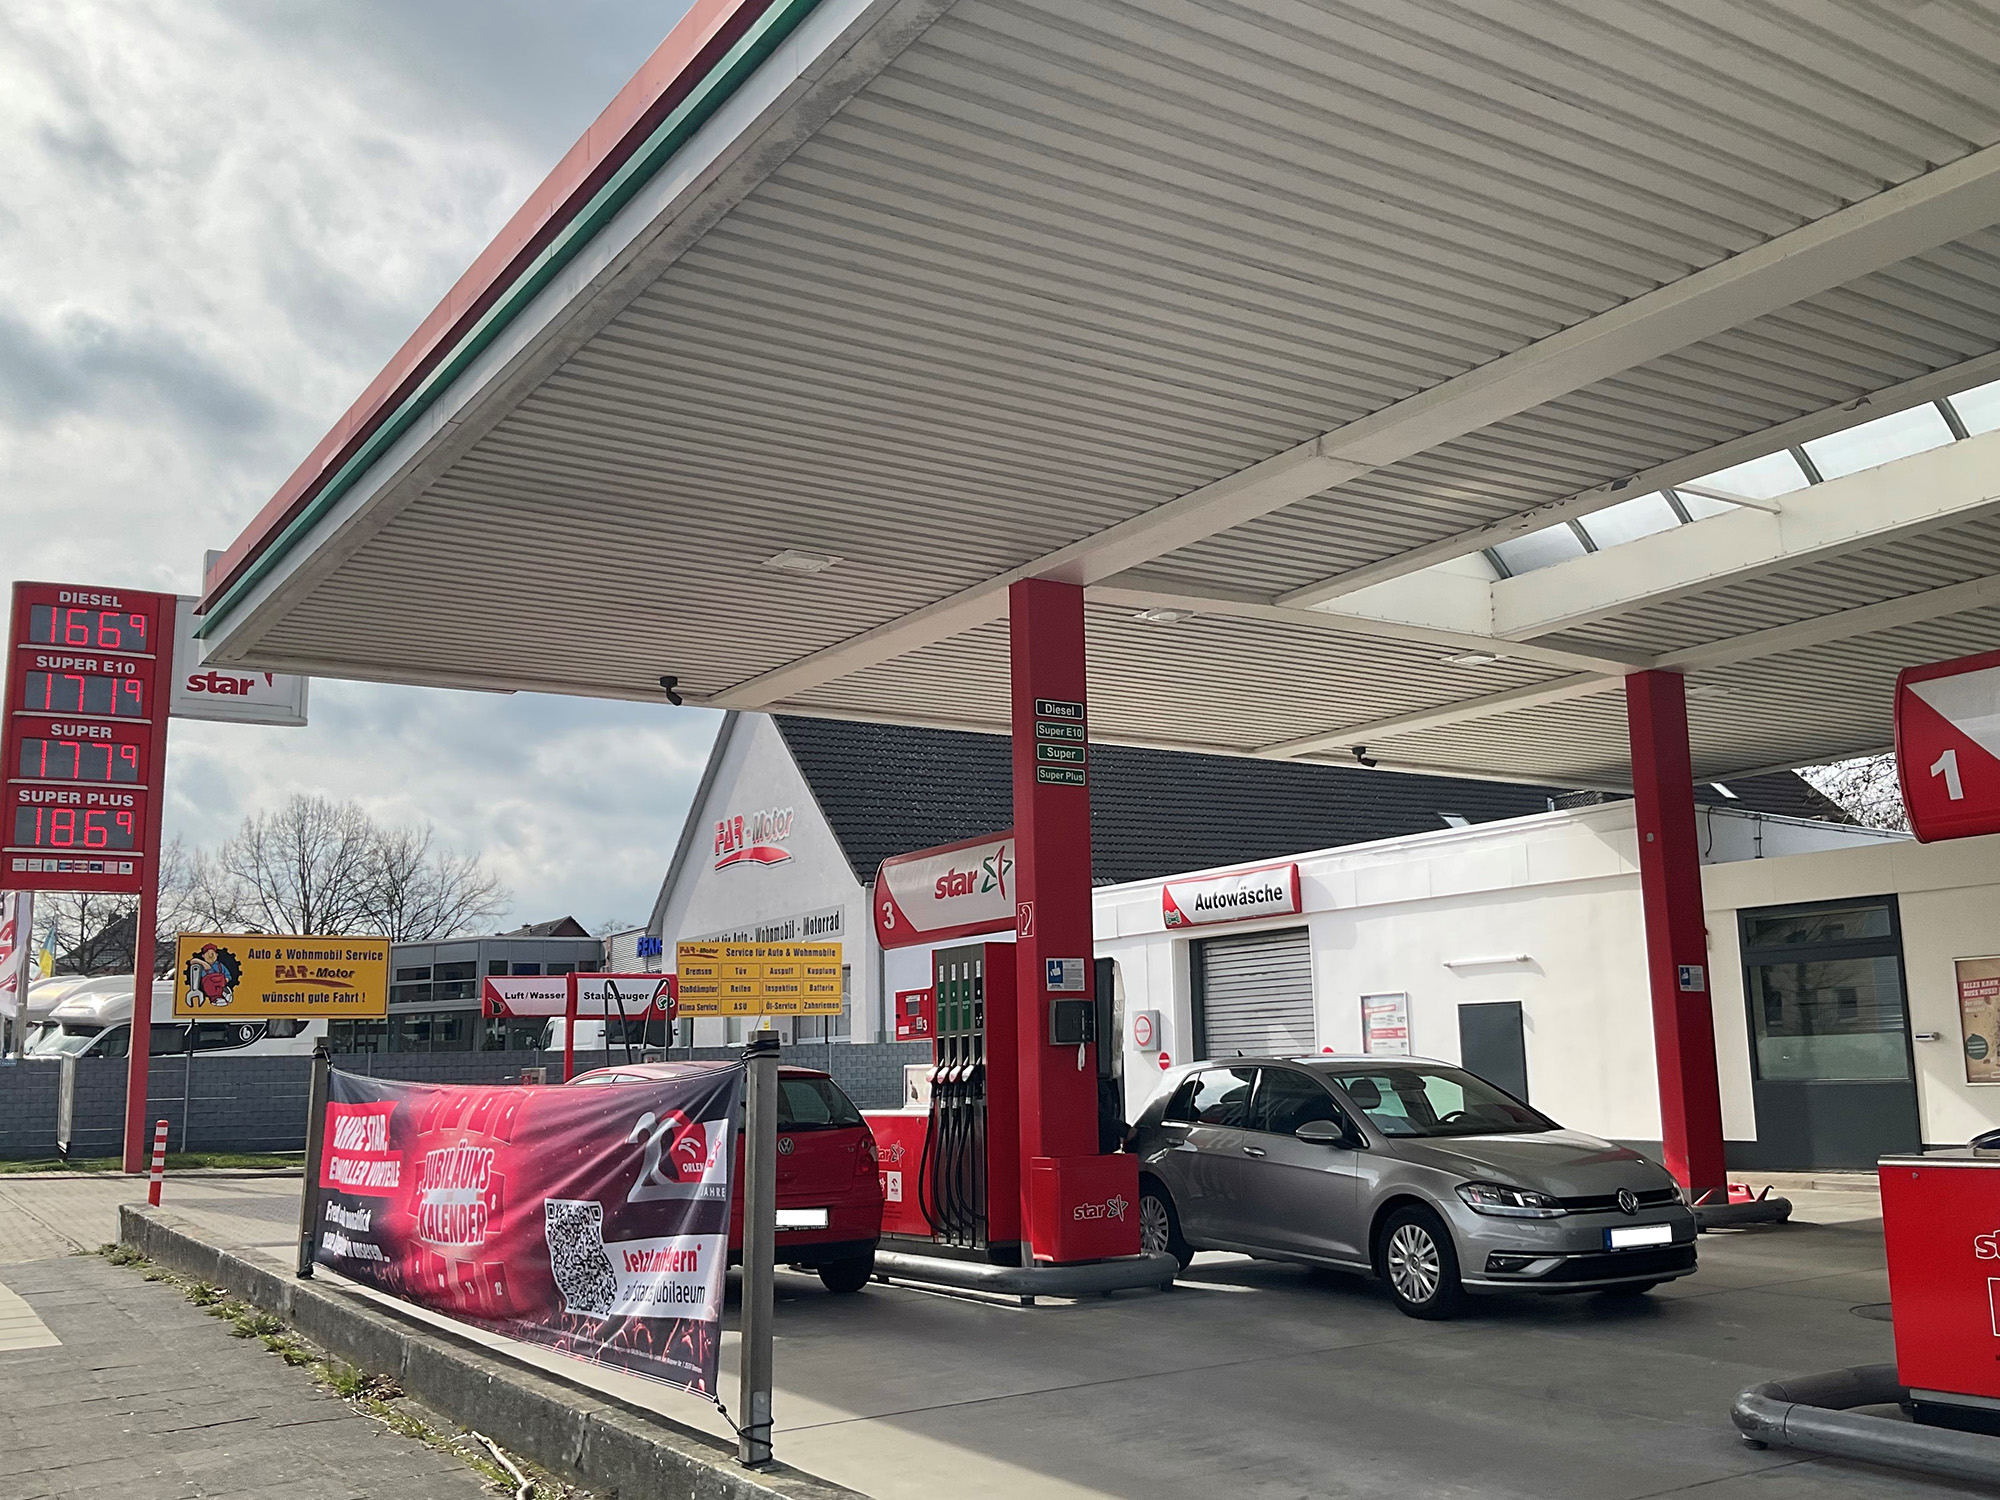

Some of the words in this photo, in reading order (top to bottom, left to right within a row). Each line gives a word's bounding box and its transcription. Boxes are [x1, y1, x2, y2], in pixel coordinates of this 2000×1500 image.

[59, 591, 122, 608] DIESEL
[50, 606, 145, 649] 1669
[36, 655, 97, 671] SUPER
[103, 661, 136, 675] E10
[186, 671, 255, 696] star
[45, 672, 141, 714] 1719
[1045, 703, 1075, 716] Diesel
[51, 723, 112, 739] SUPER
[1039, 725, 1064, 736] Super
[1066, 727, 1082, 737] E10
[1047, 747, 1076, 759] Super
[40, 739, 137, 781] 1779
[1040, 769, 1064, 780] Super
[1065, 772, 1083, 781] Plus
[1930, 749, 1964, 801] 1
[18, 789, 82, 804] SUPER
[87, 793, 134, 807] PLUS
[35, 807, 132, 848] 1869
[935, 867, 978, 899] star
[1194, 884, 1283, 912] Autowäsche
[882, 902, 895, 930] 3
[754, 920, 795, 943] Wohnmobil
[803, 910, 840, 936] Motorrad
[248, 948, 271, 960] Auto
[275, 949, 282, 960] &
[286, 949, 342, 961] Wohnmobil
[346, 950, 383, 961] Service
[726, 948, 754, 957] Service
[755, 948, 766, 957] für
[767, 948, 784, 957] Auto
[785, 948, 791, 957] &
[793, 948, 836, 957] Wohnmobile
[685, 967, 712, 976] Bremsen
[770, 967, 794, 976] Auspuff
[807, 967, 836, 976] Kupplung
[730, 984, 751, 993] Reifen
[765, 984, 798, 993] Inspektion
[809, 984, 834, 992] Batterie
[262, 992, 305, 1003] wünscht
[308, 993, 329, 1004] gute
[333, 992, 359, 1003] Fahrt
[679, 1003, 695, 1011] Klima
[696, 1003, 718, 1011] Service
[734, 1002, 748, 1010] ASU
[766, 1001, 797, 1009] Öl-Service
[804, 1001, 839, 1009] Zahnriemen
[922, 1019, 928, 1031] 3
[422, 1138, 494, 1192] JUBILÄUMS
[682, 1162, 705, 1173] ORLEN
[700, 1187, 726, 1198] JAHRE
[1074, 1203, 1105, 1220] star
[418, 1200, 487, 1247] KALENDER
[623, 1248, 654, 1273] Jetzt
